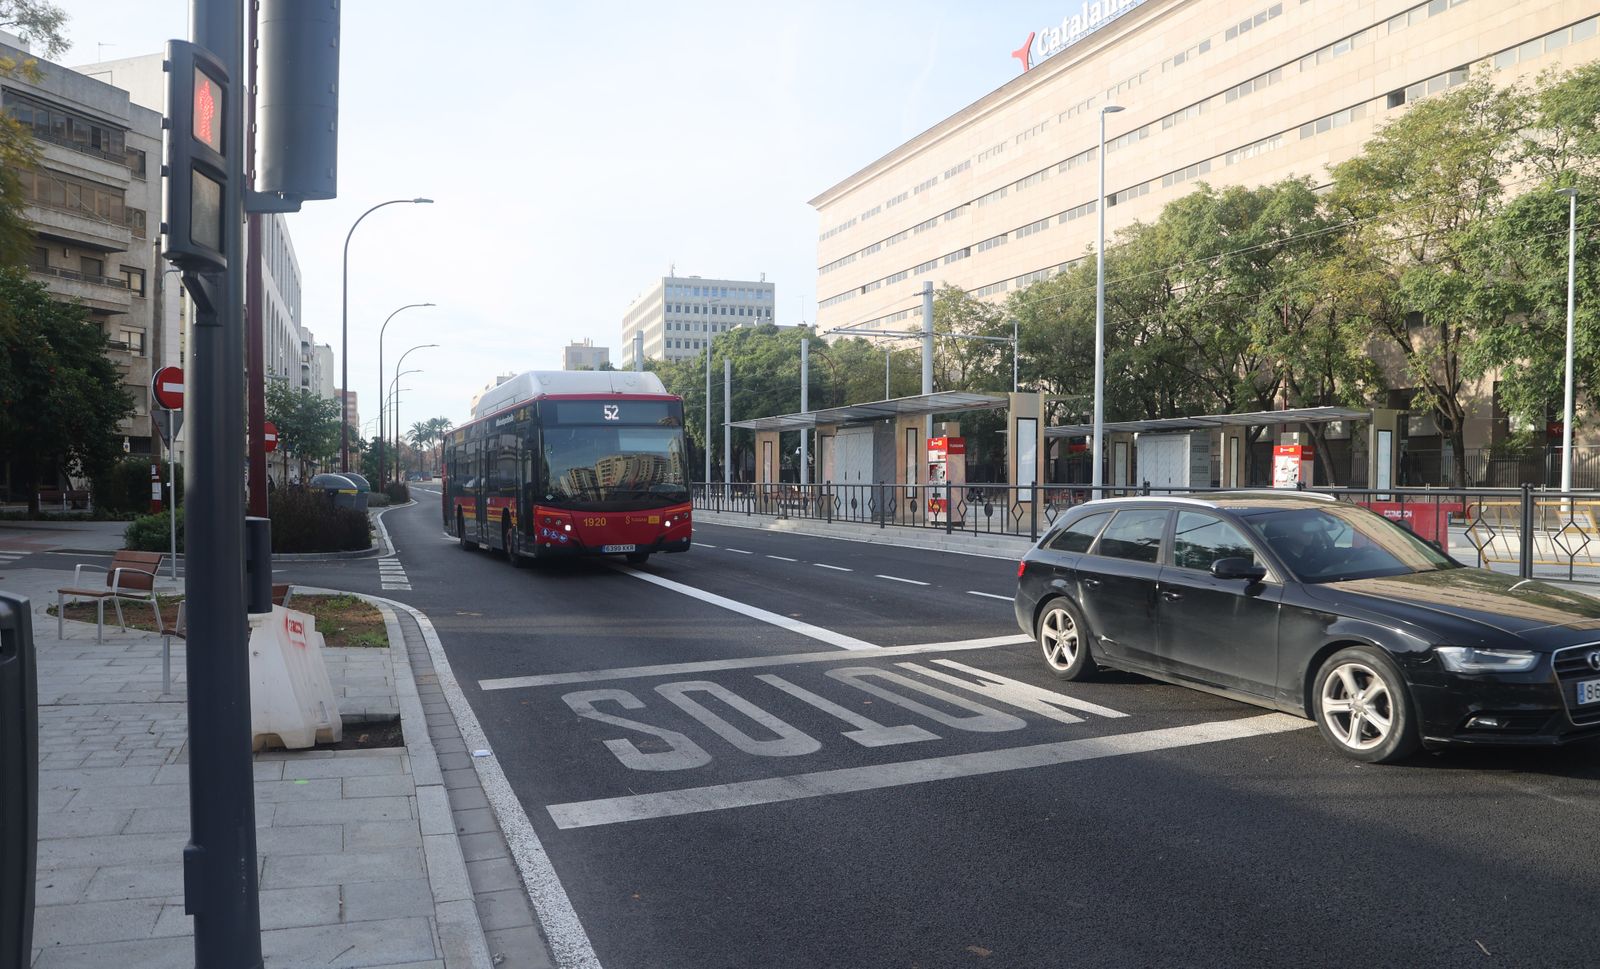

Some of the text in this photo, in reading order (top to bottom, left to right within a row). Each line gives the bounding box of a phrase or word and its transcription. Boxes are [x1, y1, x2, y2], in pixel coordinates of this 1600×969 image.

[604, 405, 619, 420] 52
[583, 516, 607, 527] 1920
[1586, 682, 1600, 700] 86
[562, 658, 1130, 771] MOTOS
